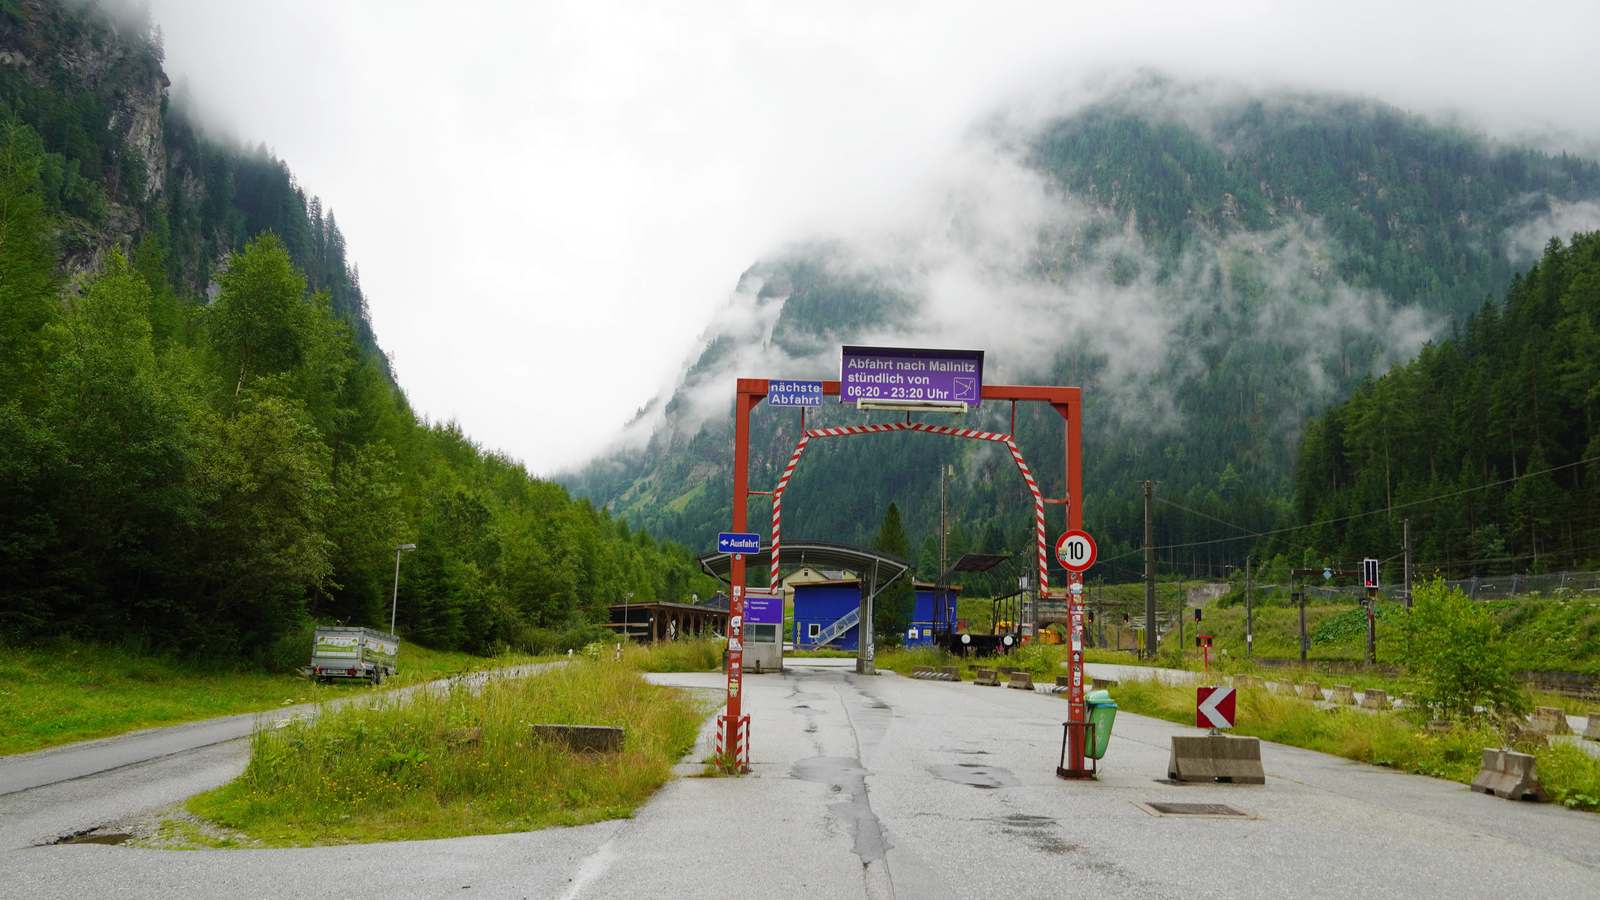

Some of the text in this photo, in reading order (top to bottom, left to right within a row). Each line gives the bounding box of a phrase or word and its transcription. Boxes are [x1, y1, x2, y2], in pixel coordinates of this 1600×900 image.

[848, 358, 976, 372] Abfahrt nach Mallnitz
[848, 372, 930, 384] stündlich von
[771, 382, 820, 393] nächste
[847, 385, 880, 397] 06:20
[891, 387, 923, 398] 23:20
[927, 388, 949, 399] Uhr
[771, 393, 819, 405] Abfahrt
[730, 538, 759, 548] Ausfahrt
[1068, 541, 1084, 560] 10
